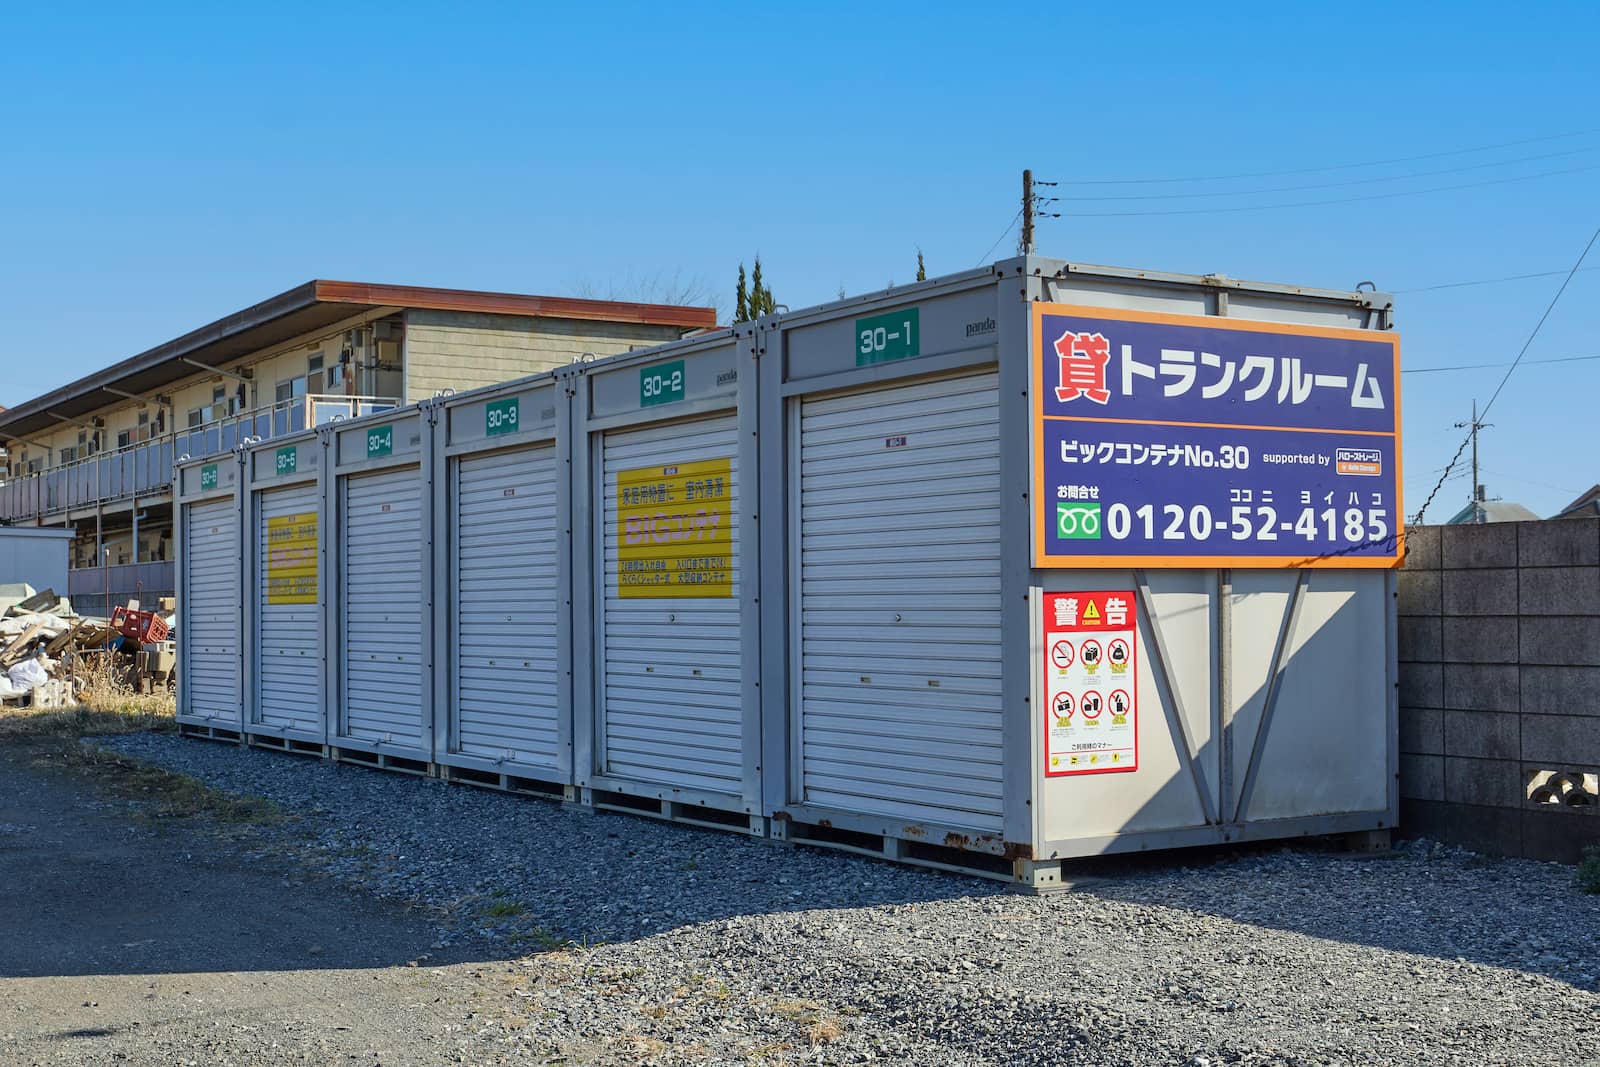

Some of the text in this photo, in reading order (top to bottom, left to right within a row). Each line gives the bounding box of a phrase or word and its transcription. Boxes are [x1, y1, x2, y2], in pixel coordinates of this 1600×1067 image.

[860, 320, 913, 354] 30-1
[966, 317, 995, 337] panda
[643, 370, 682, 398] 30-2
[487, 404, 518, 427] 30-3
[368, 430, 392, 452] 30-4
[276, 452, 296, 472] 30-5
[1262, 452, 1315, 466] supported
[1318, 454, 1331, 467] by
[1057, 485, 1099, 499] お問合せ
[1107, 503, 1388, 542] 0120-52-4185
